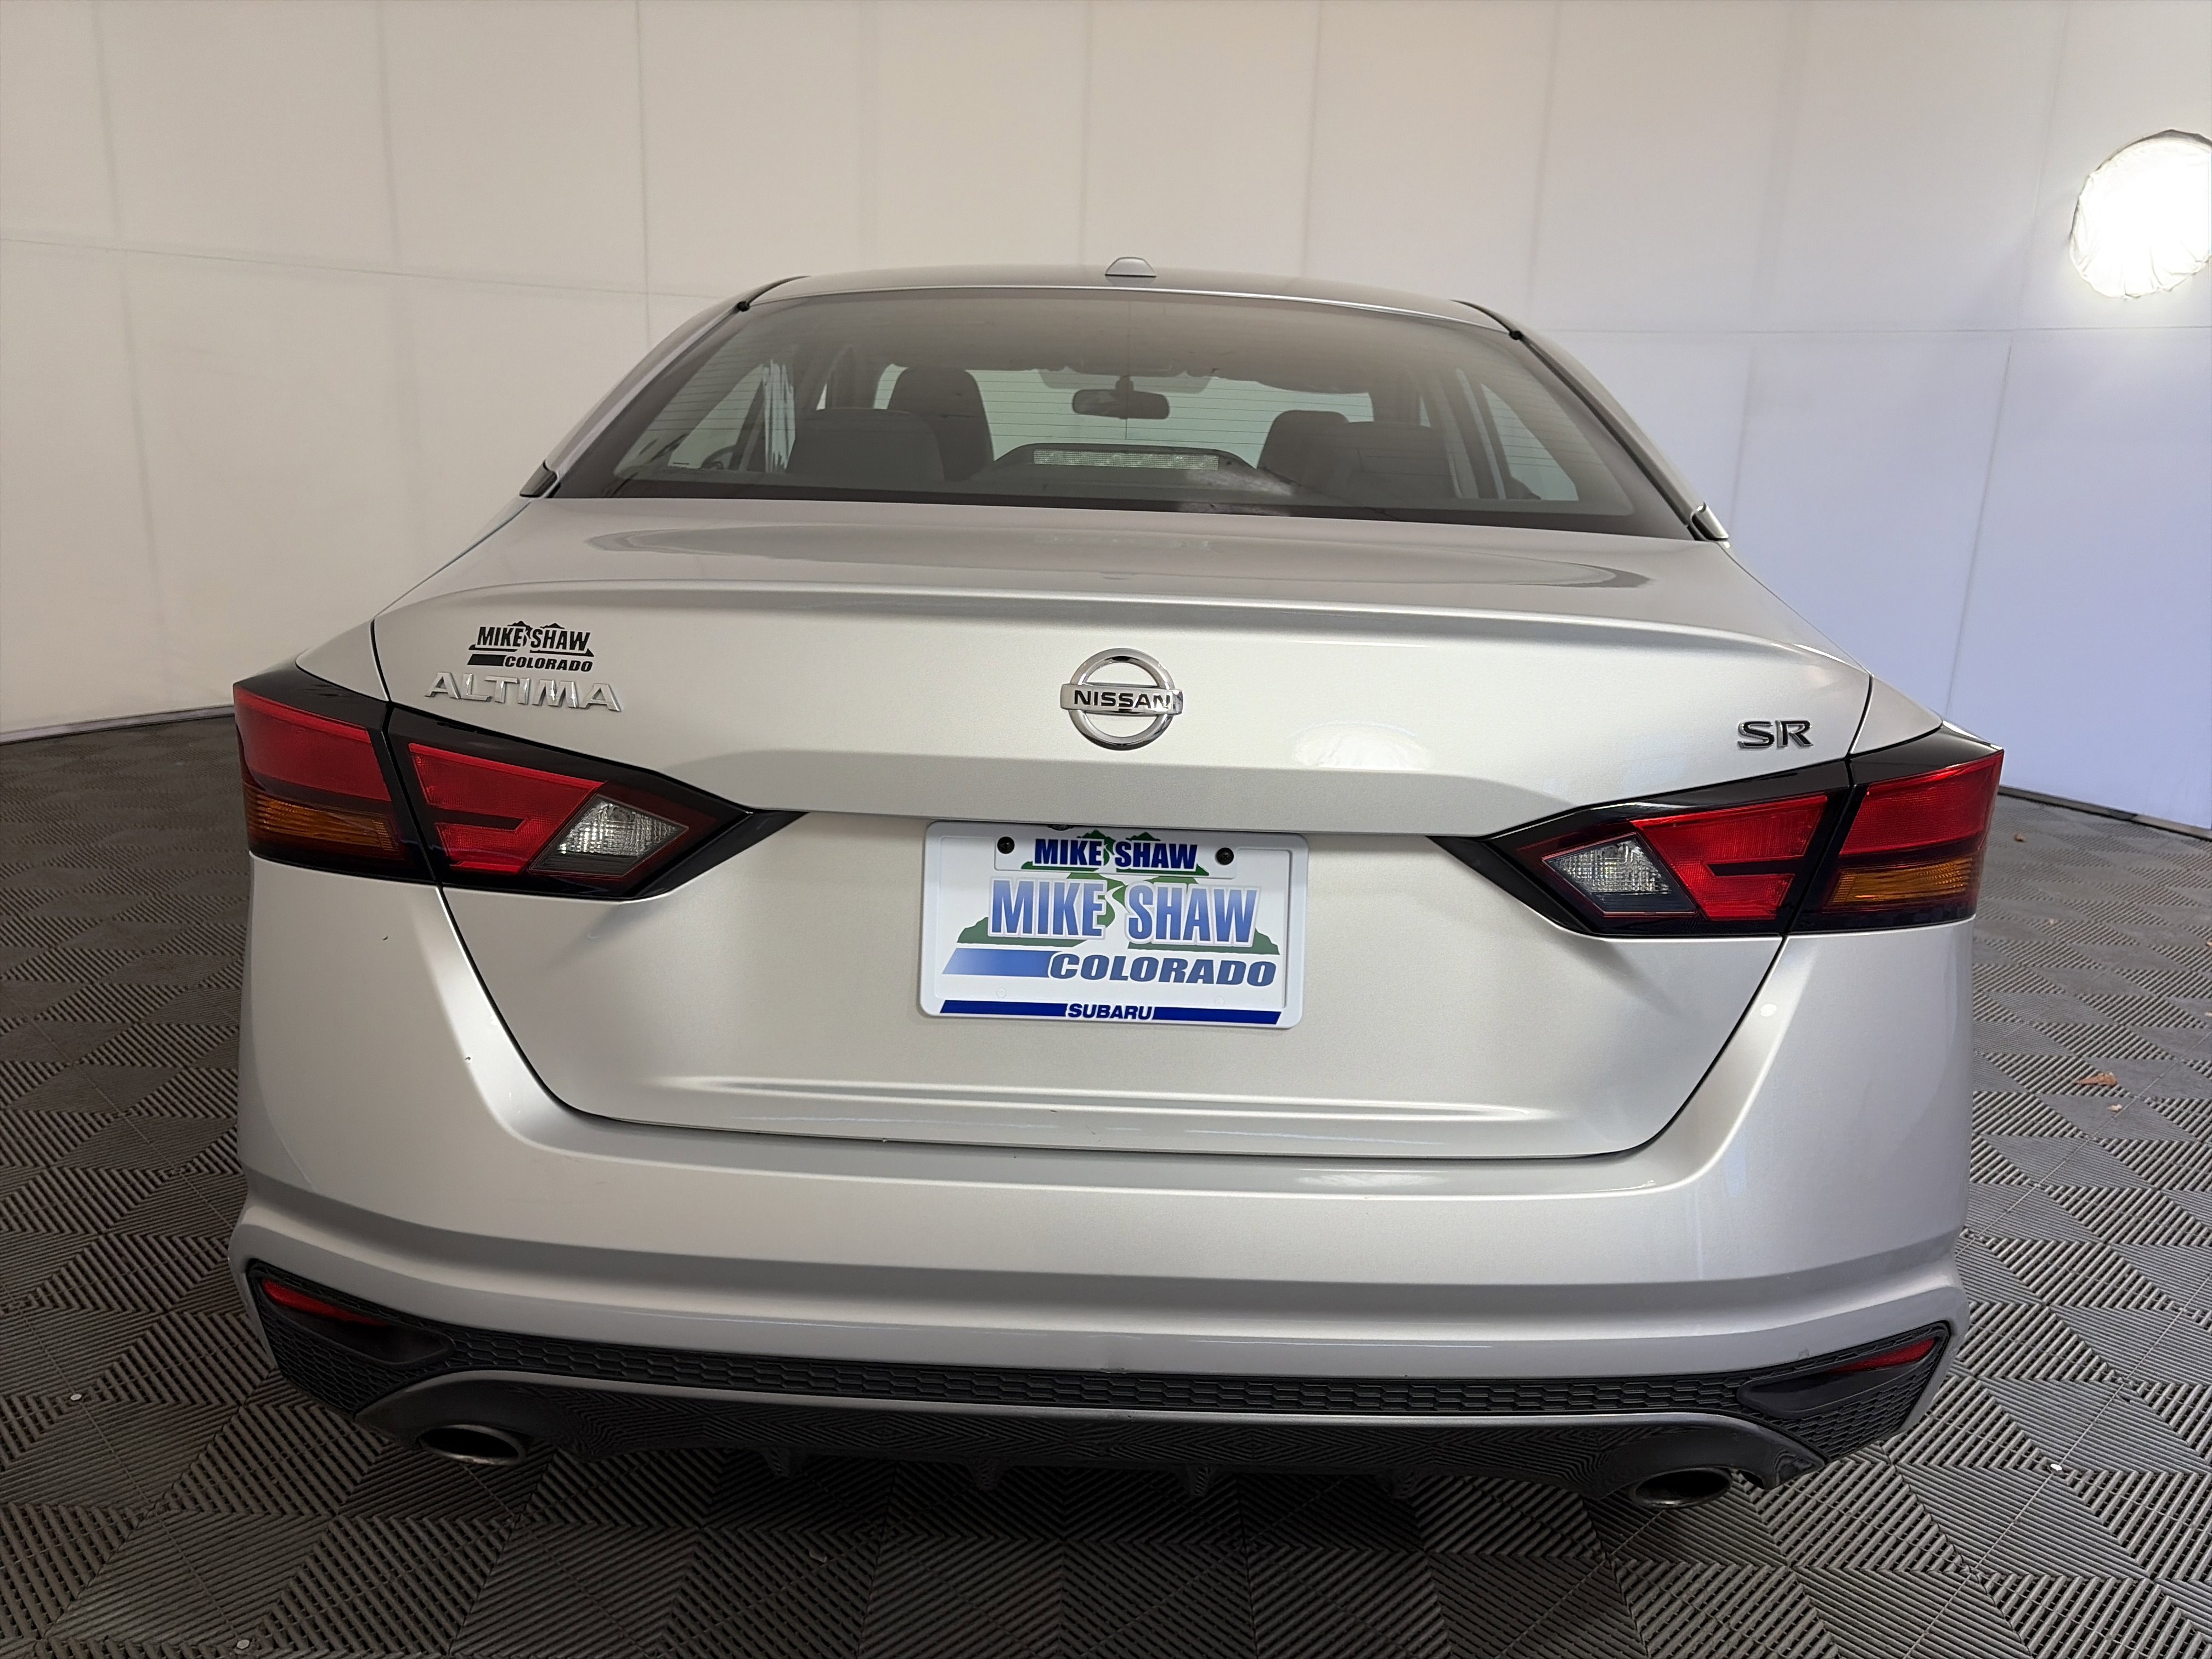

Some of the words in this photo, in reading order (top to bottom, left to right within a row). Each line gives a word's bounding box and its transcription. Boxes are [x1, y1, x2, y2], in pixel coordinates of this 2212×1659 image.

[477, 627, 524, 646] MIKE
[531, 629, 591, 651] SHAW
[505, 656, 593, 672] COLORADO
[425, 672, 622, 712] ALTIMA
[1074, 690, 1171, 709] NISSAN
[1737, 720, 1814, 749] SR
[1034, 838, 1103, 866] MIKE
[1114, 843, 1198, 870] SHAW
[991, 879, 1105, 937] MIKE
[1127, 884, 1257, 944] SHAW
[1050, 953, 1277, 986] COLORADO
[1068, 1003, 1153, 1020] SUBARU
